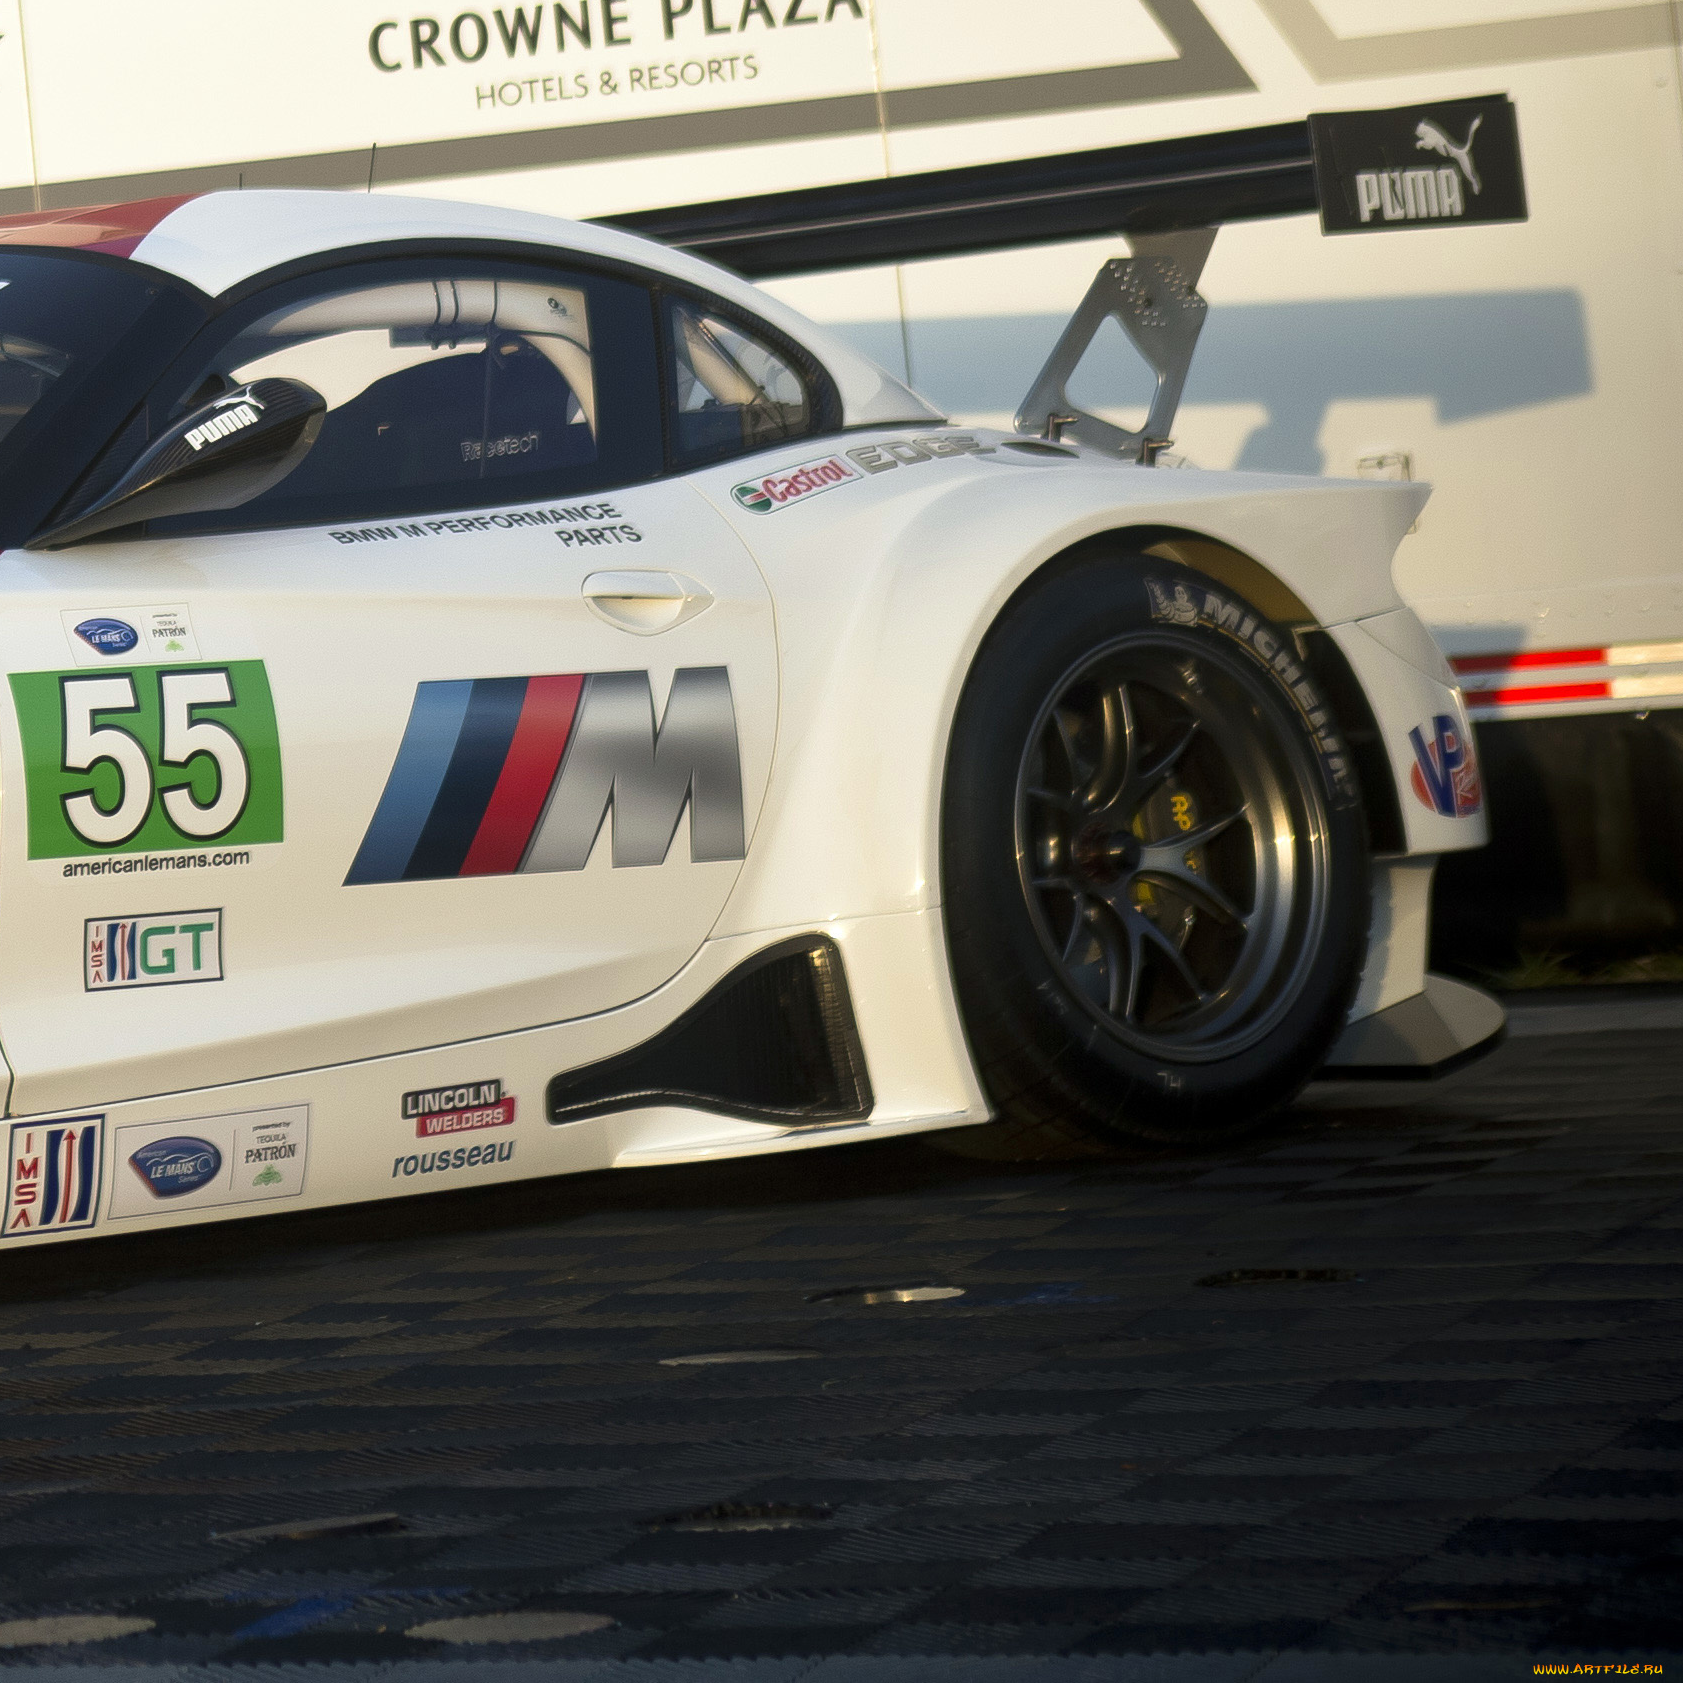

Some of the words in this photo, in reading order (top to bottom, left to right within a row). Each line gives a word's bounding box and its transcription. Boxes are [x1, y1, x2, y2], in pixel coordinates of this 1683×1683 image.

[475, 73, 589, 110] HOTELS
[598, 70, 619, 95] &
[629, 55, 759, 93] RESORTS
[1355, 167, 1464, 224] PUMA
[184, 403, 259, 453] PUMA
[761, 459, 854, 504] Castrol
[844, 435, 997, 476] EDGE
[328, 523, 399, 546] BMW
[397, 519, 428, 539] M
[427, 503, 622, 536] PERFORMANCE
[555, 524, 643, 549] PARTS
[58, 666, 252, 849] 55
[1407, 713, 1466, 819] VP
[62, 850, 251, 878] americanlemans.com
[90, 924, 104, 984] IMSA
[139, 922, 215, 976] GT
[405, 1084, 499, 1117] LINCOLN
[425, 1107, 505, 1137] WELDERS
[244, 1141, 297, 1164] PATRÓN
[256, 1133, 287, 1144] TEQUILA
[391, 1139, 514, 1179] rousseau
[10, 1132, 40, 1229] IMSA
[150, 1166, 164, 1179] LE
[166, 1162, 197, 1178] MANS
